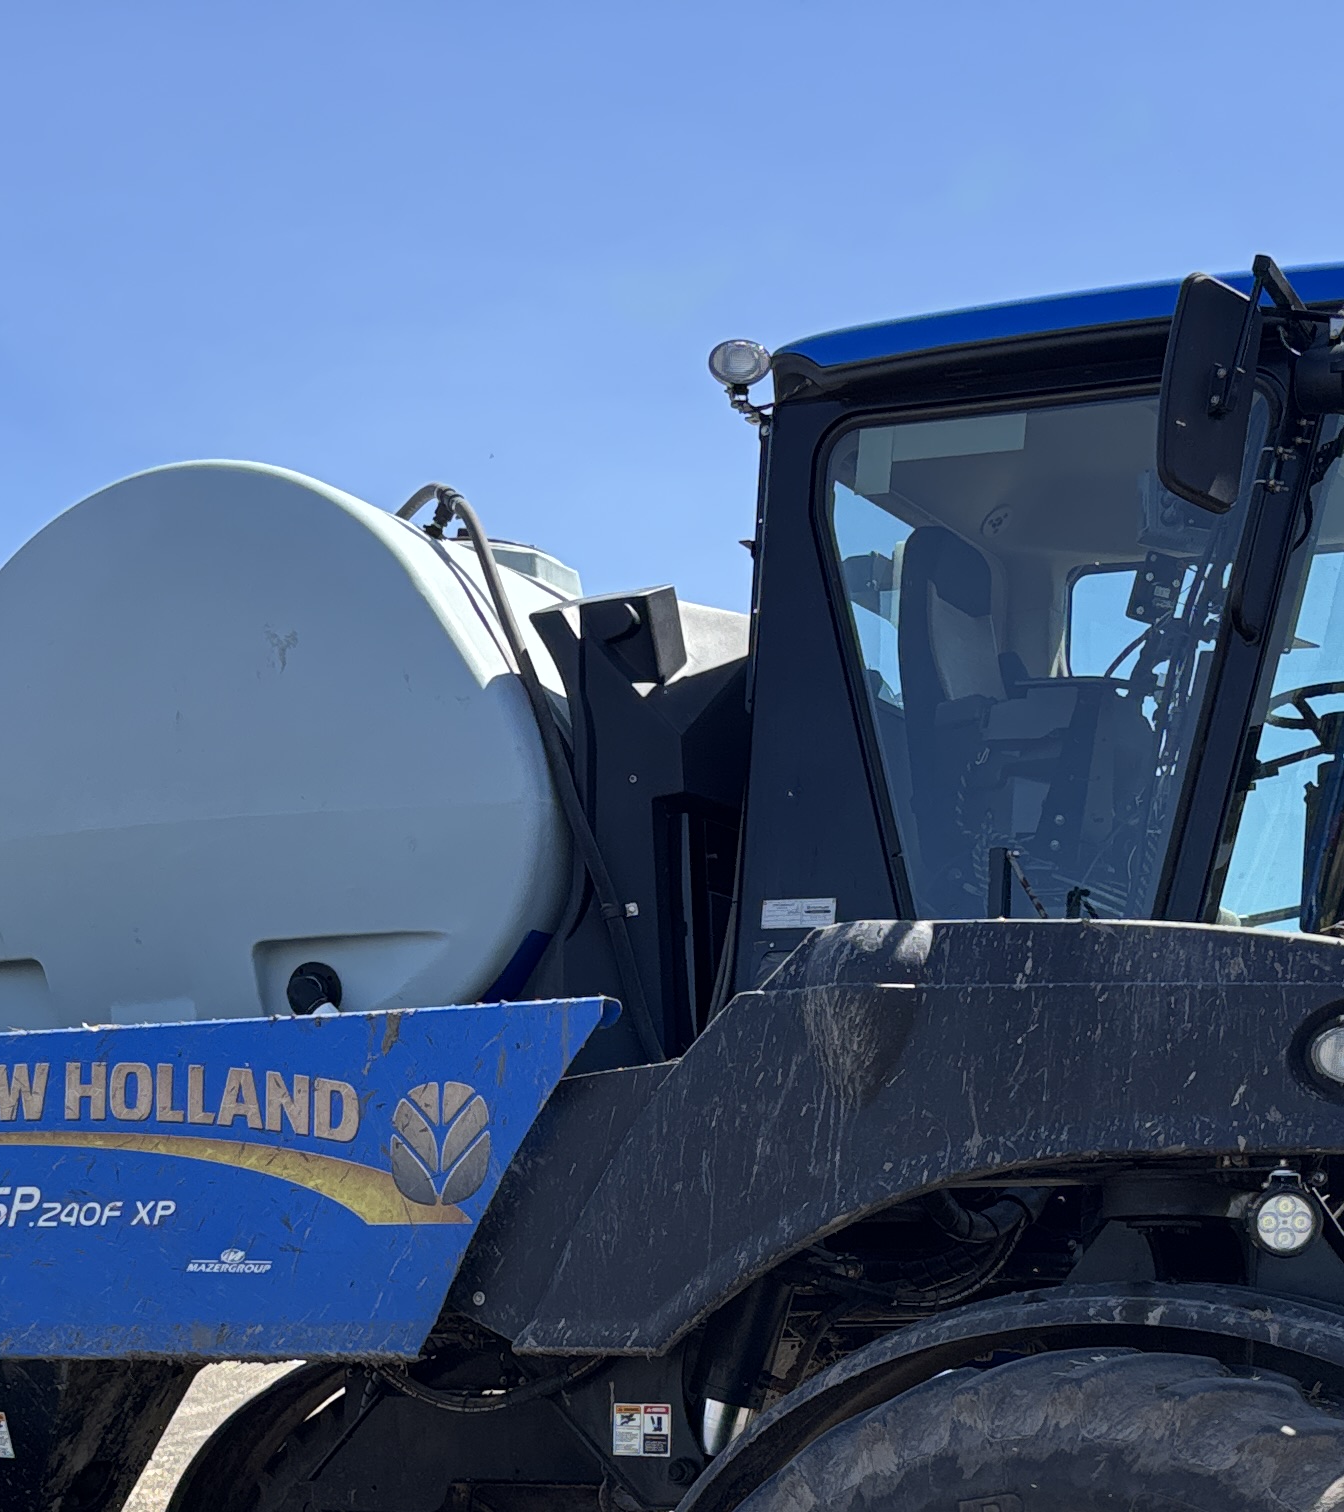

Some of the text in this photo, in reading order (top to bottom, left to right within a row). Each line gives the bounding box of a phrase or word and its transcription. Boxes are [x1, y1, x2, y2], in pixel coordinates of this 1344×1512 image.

[64, 1061, 361, 1143] HOLLAND
[130, 1200, 177, 1226] XP
[185, 1263, 272, 1274] MAZERGROUP
